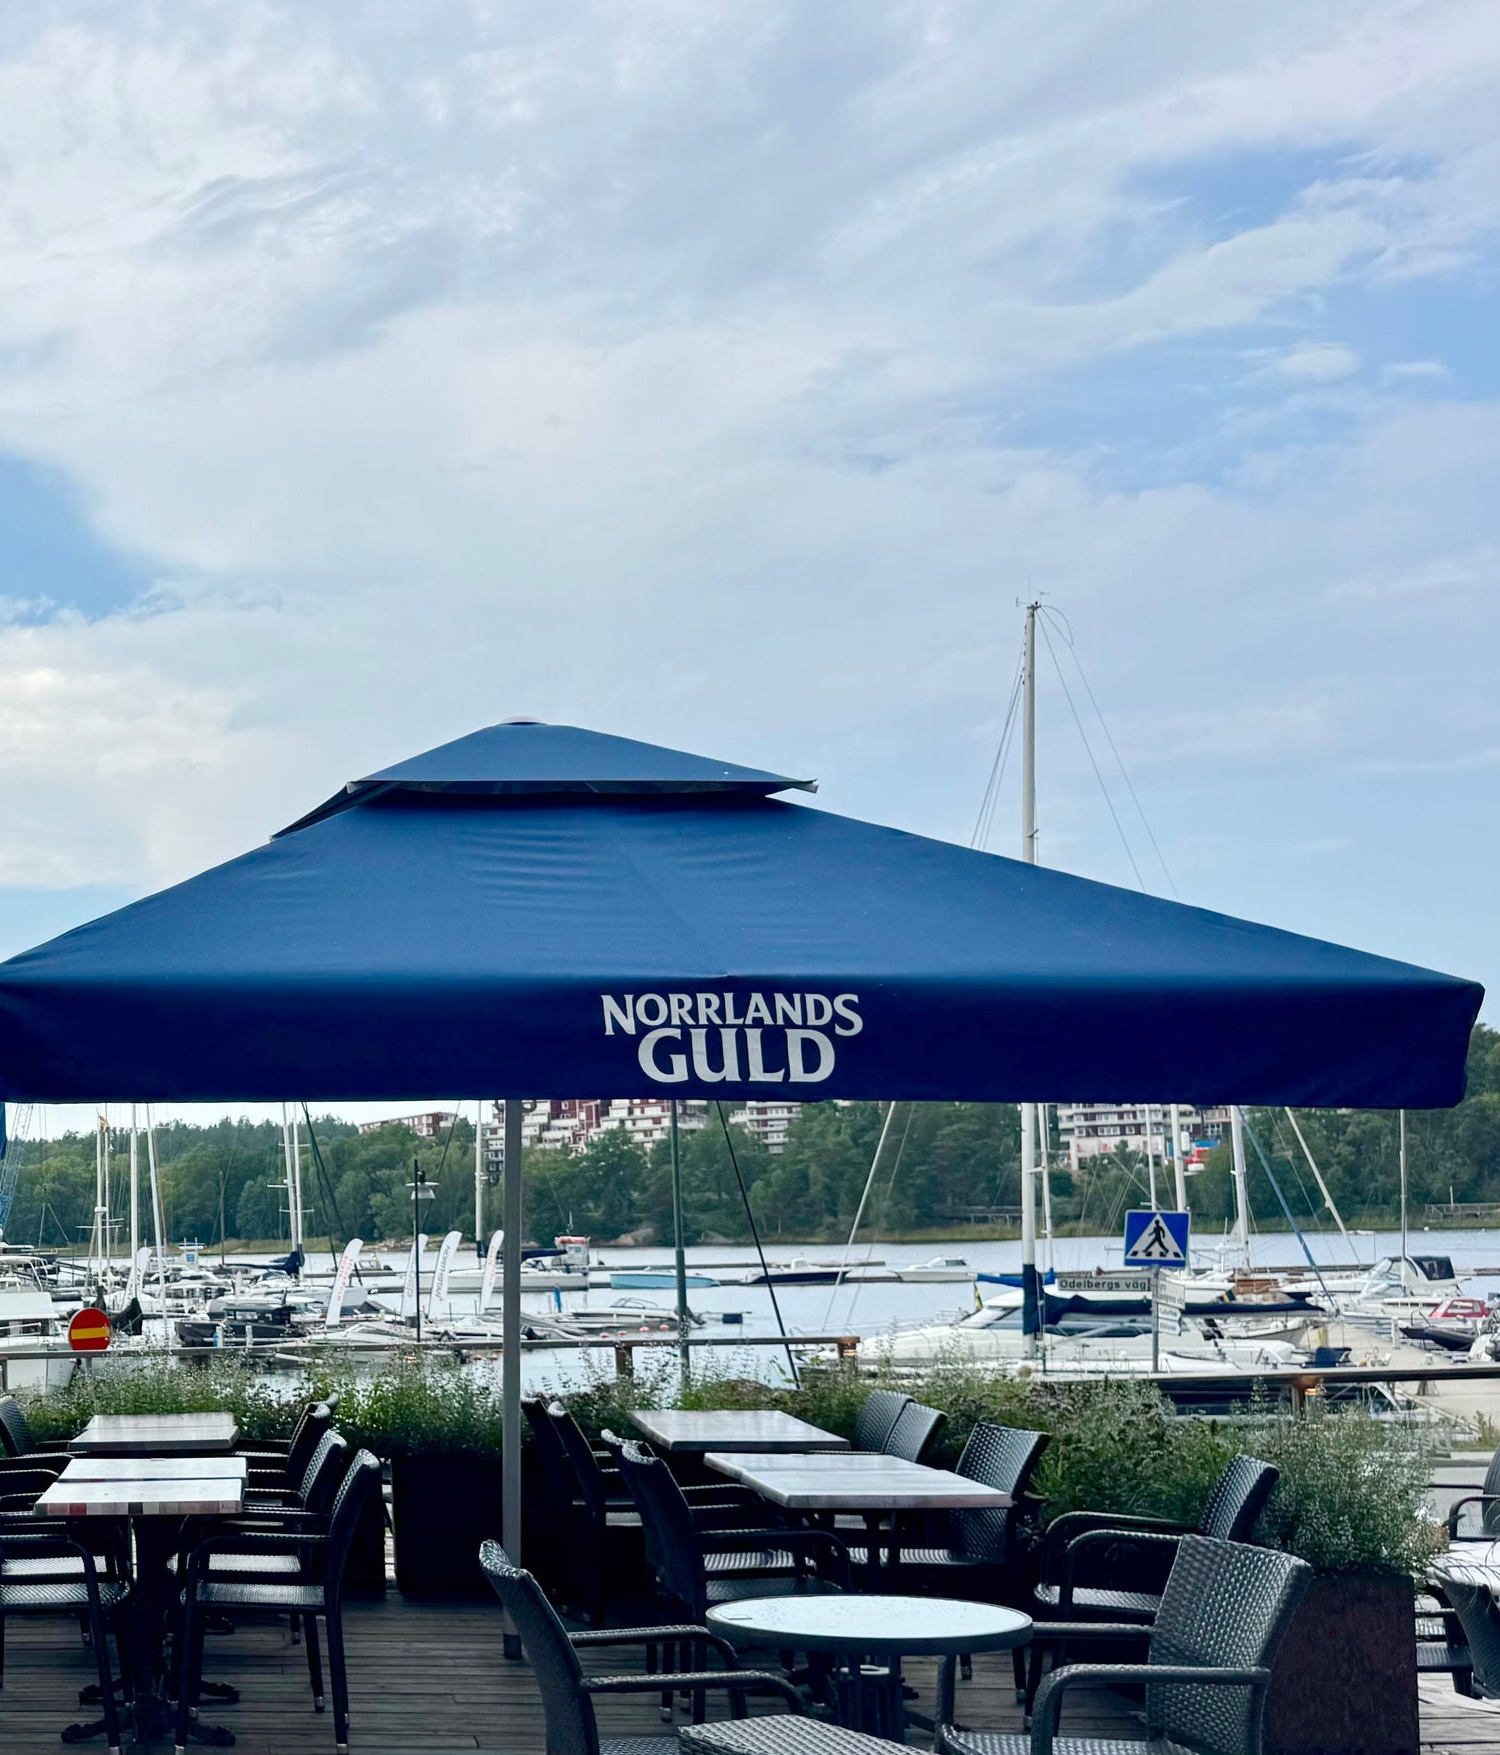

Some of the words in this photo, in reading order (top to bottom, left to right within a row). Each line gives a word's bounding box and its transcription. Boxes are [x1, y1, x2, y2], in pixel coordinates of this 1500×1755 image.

[600, 991, 864, 1037] NORRLANDS
[637, 1027, 836, 1083] GULD
[1060, 1279, 1120, 1290] Odelbergs
